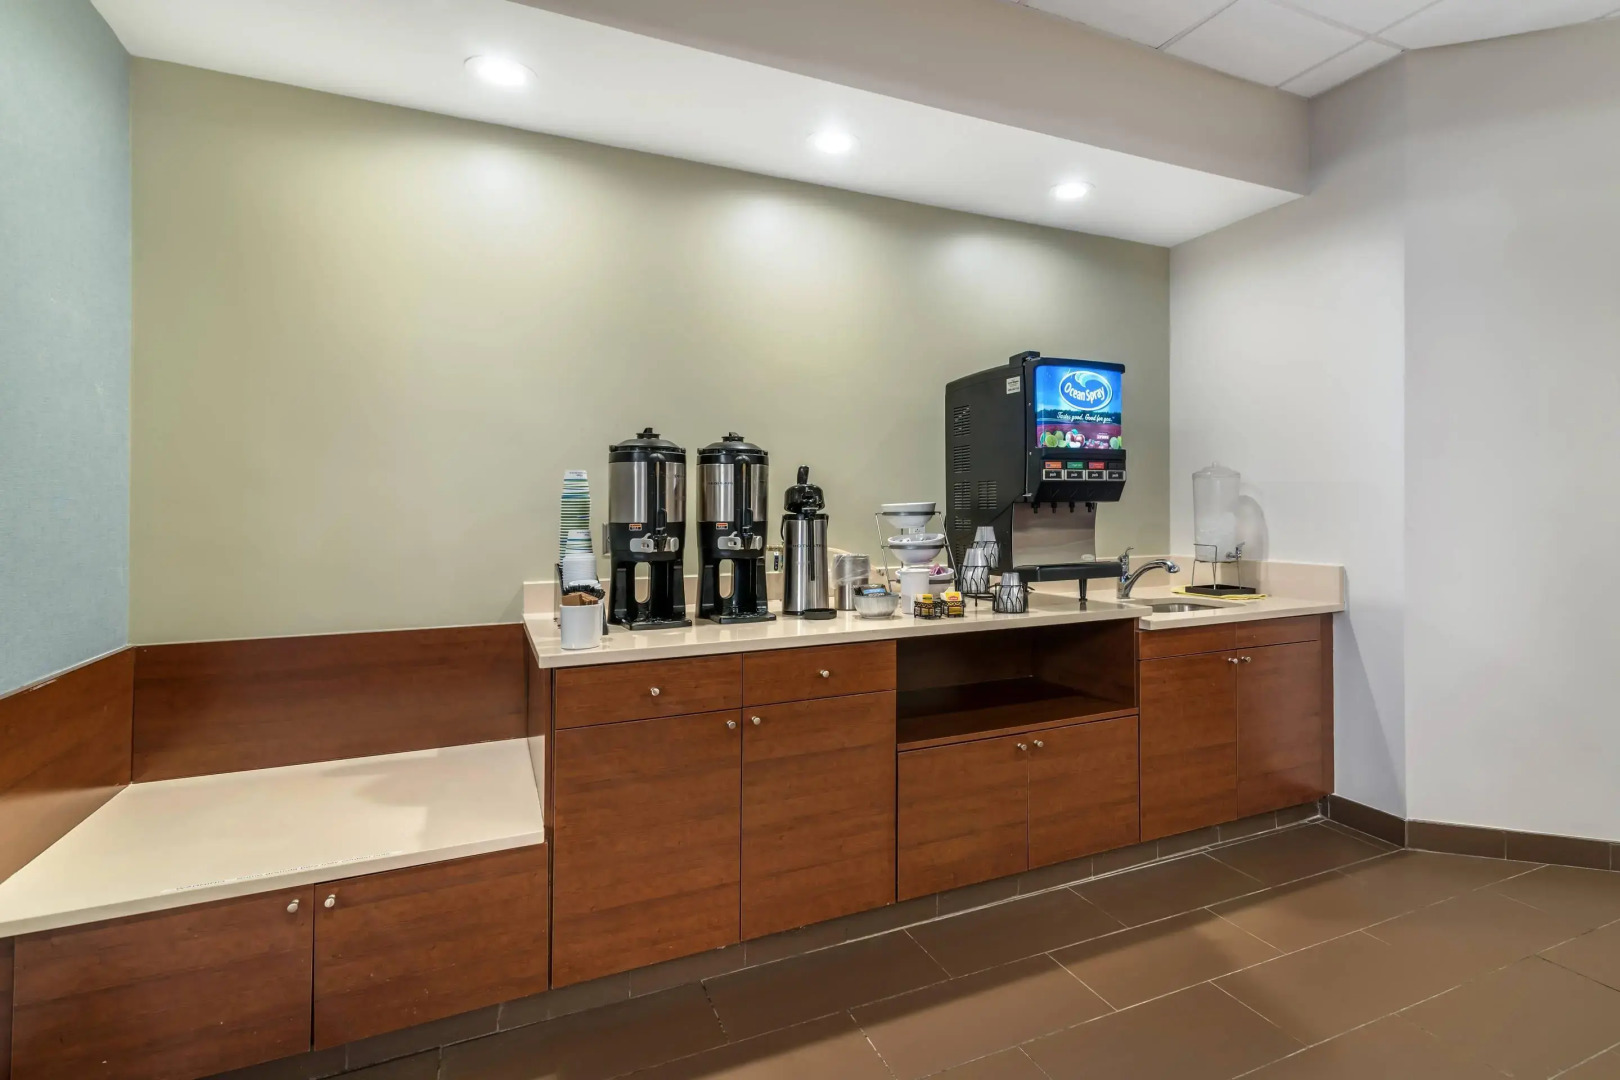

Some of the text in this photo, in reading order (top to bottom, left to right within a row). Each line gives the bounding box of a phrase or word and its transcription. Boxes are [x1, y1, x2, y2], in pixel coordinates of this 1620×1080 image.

[1064, 382, 1105, 404] Ocean Spray
[1057, 412, 1071, 420] Tastes
[1085, 413, 1096, 421] Good
